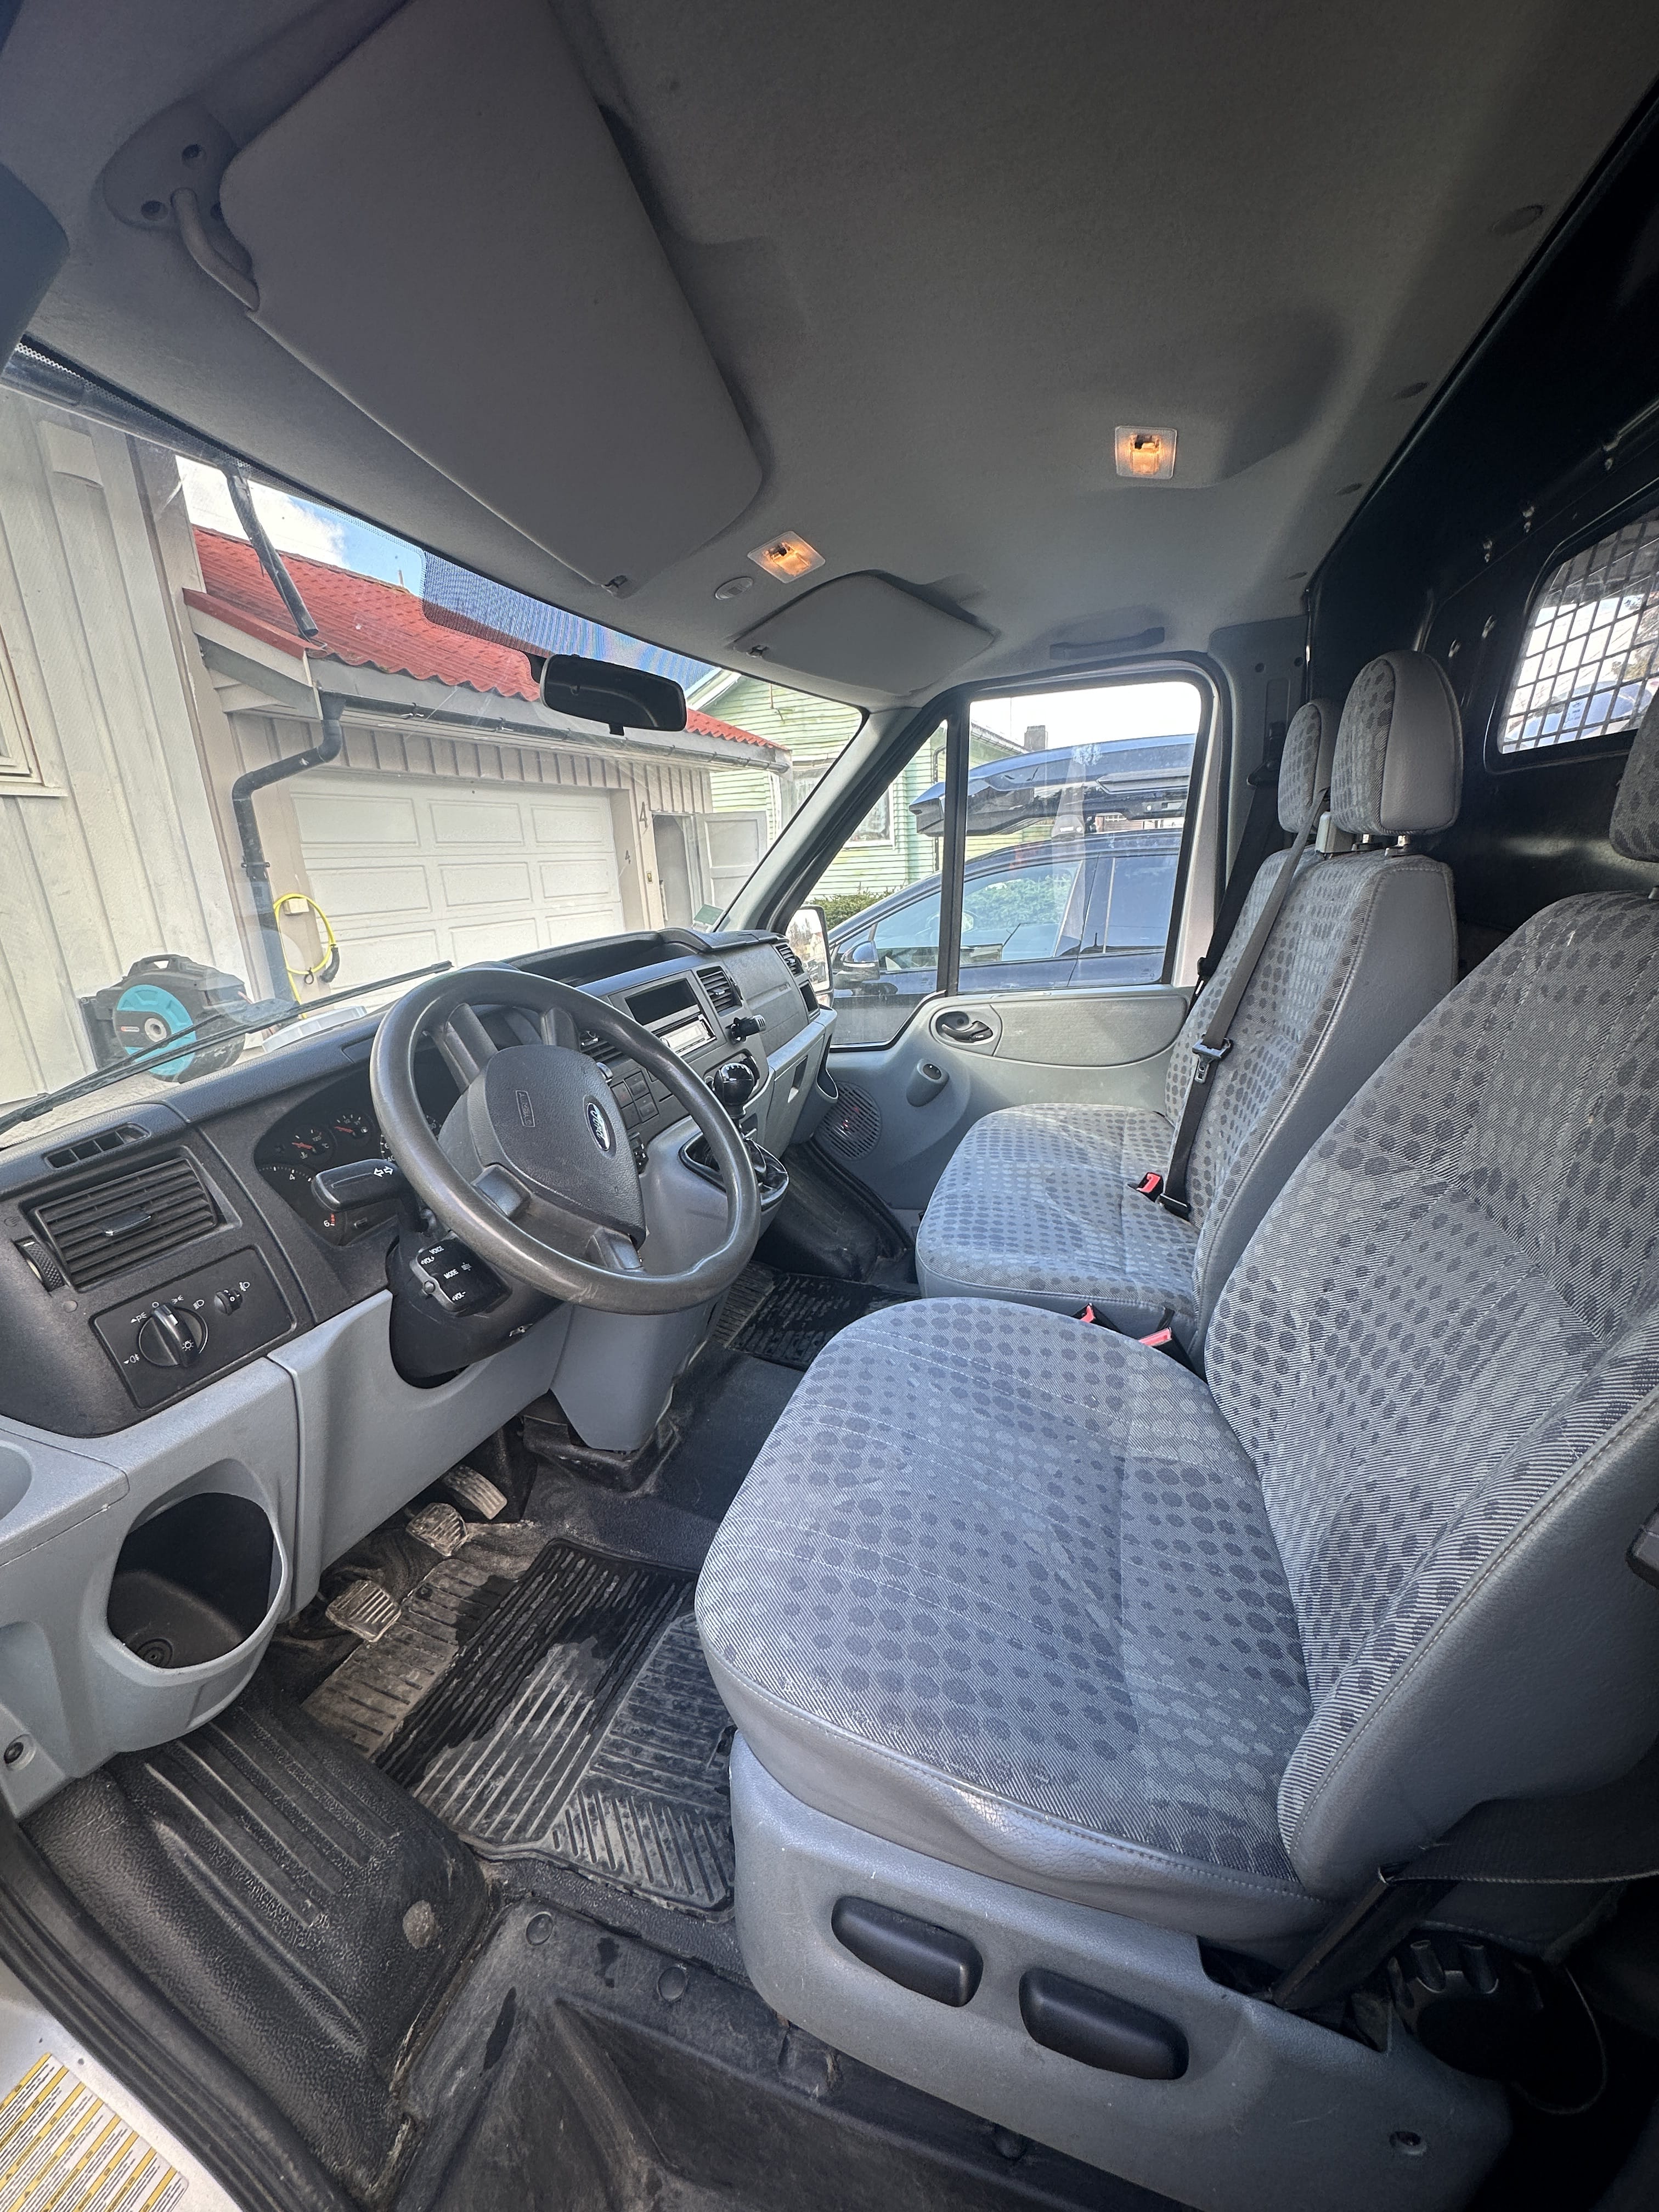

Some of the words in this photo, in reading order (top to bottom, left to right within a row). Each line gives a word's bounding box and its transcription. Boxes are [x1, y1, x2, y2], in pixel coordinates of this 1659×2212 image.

[639, 801, 648, 828] 4
[429, 1245, 444, 1255] VOICE
[443, 1268, 459, 1279] MODE
